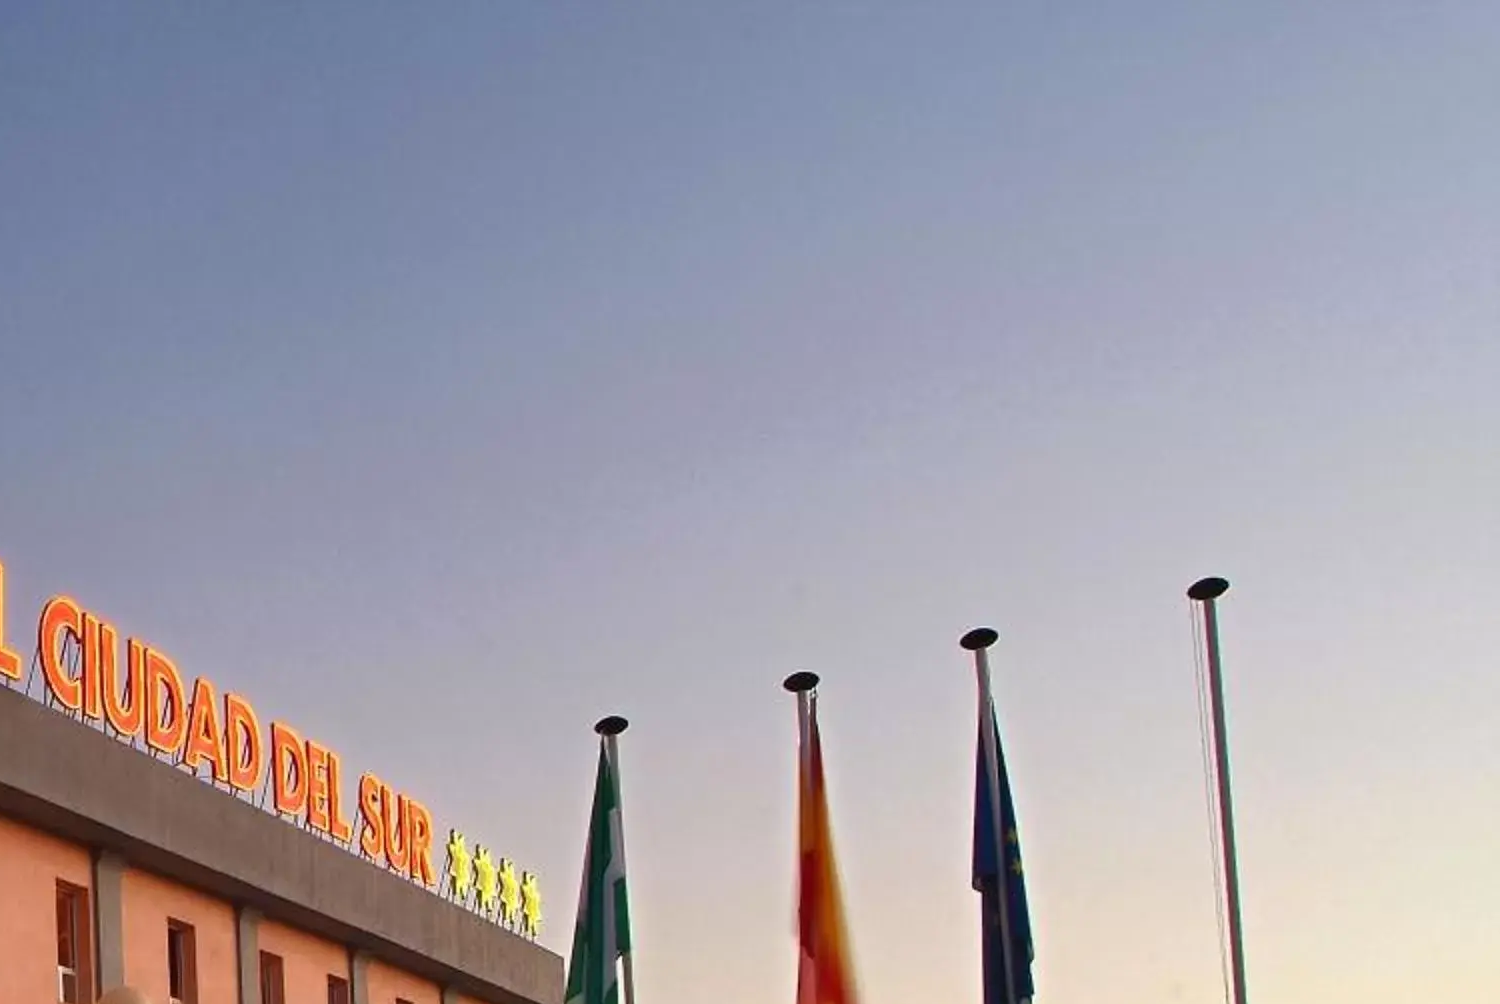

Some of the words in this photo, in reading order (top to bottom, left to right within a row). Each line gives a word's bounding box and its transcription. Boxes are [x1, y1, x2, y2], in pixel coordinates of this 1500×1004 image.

[38, 597, 263, 792] CIUDAD
[271, 720, 352, 842] DEL
[358, 772, 435, 886] SUR
